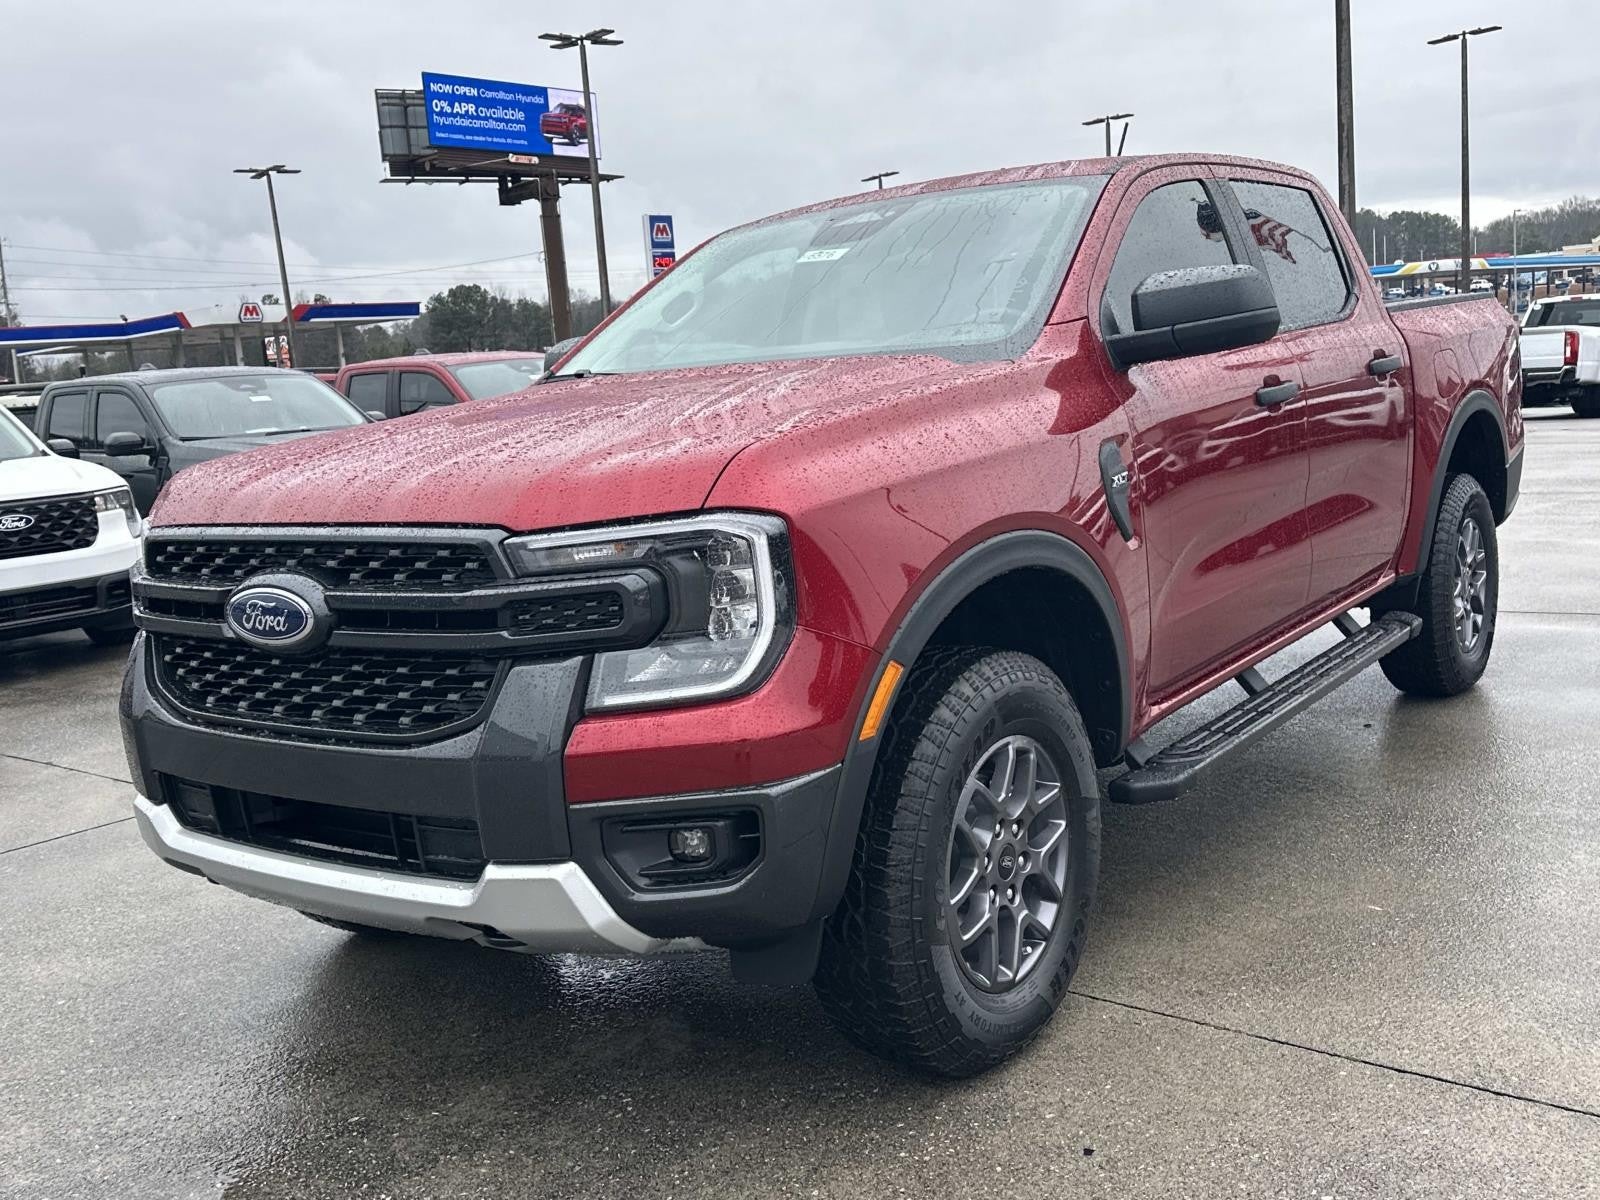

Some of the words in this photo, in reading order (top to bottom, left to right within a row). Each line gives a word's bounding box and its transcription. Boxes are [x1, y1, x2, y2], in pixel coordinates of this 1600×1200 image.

[430, 82, 453, 94] NOW
[453, 85, 478, 96] OPEN
[479, 89, 515, 101] Carrollton
[515, 93, 545, 104] Hyundai
[432, 99, 451, 113] 0%
[453, 102, 476, 116] APR
[478, 106, 525, 121] available
[433, 114, 526, 132] hyundaicarrollton.com
[243, 305, 260, 317] M
[1111, 471, 1129, 488] XLT
[0, 516, 26, 529] Ford
[242, 599, 288, 632] Ford
